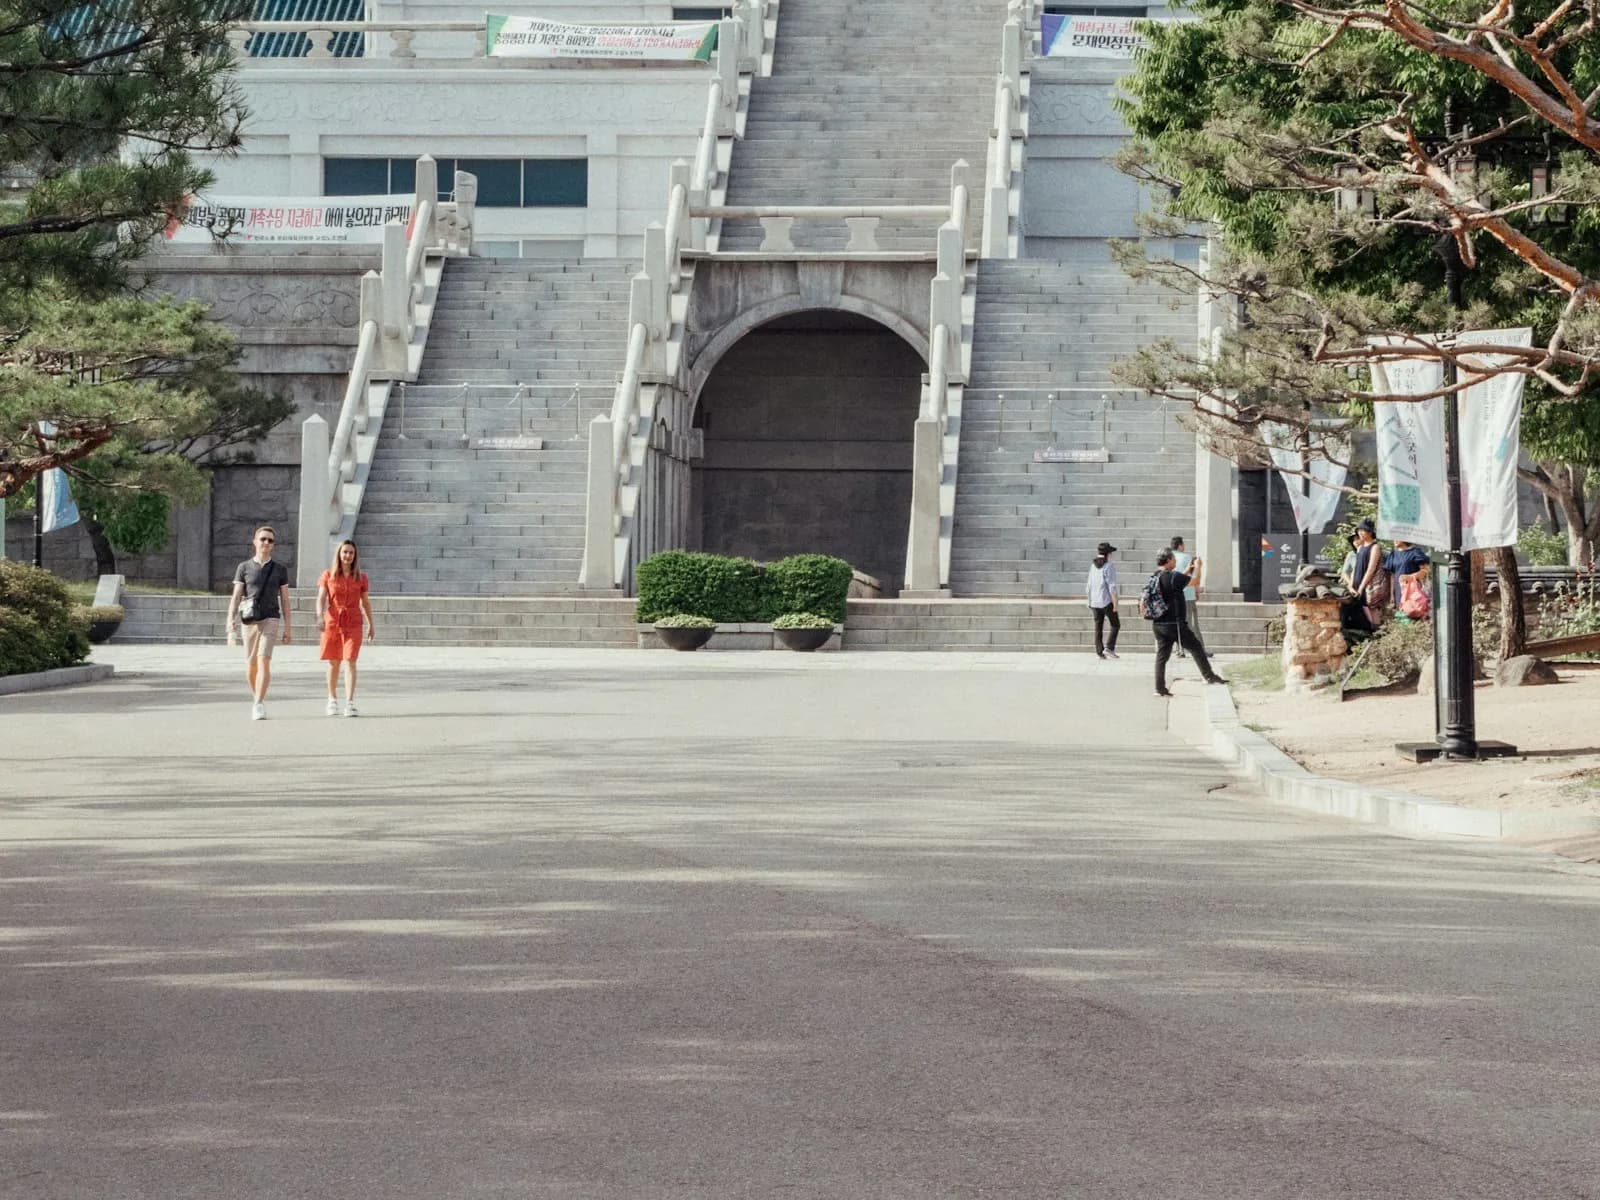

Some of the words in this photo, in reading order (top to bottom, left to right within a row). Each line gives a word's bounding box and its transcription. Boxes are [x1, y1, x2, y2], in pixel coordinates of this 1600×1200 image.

[247, 207, 284, 228] 가족수당
[286, 207, 323, 229] 지급하고
[324, 207, 343, 228] 아이
[345, 207, 382, 228] 낳으라고
